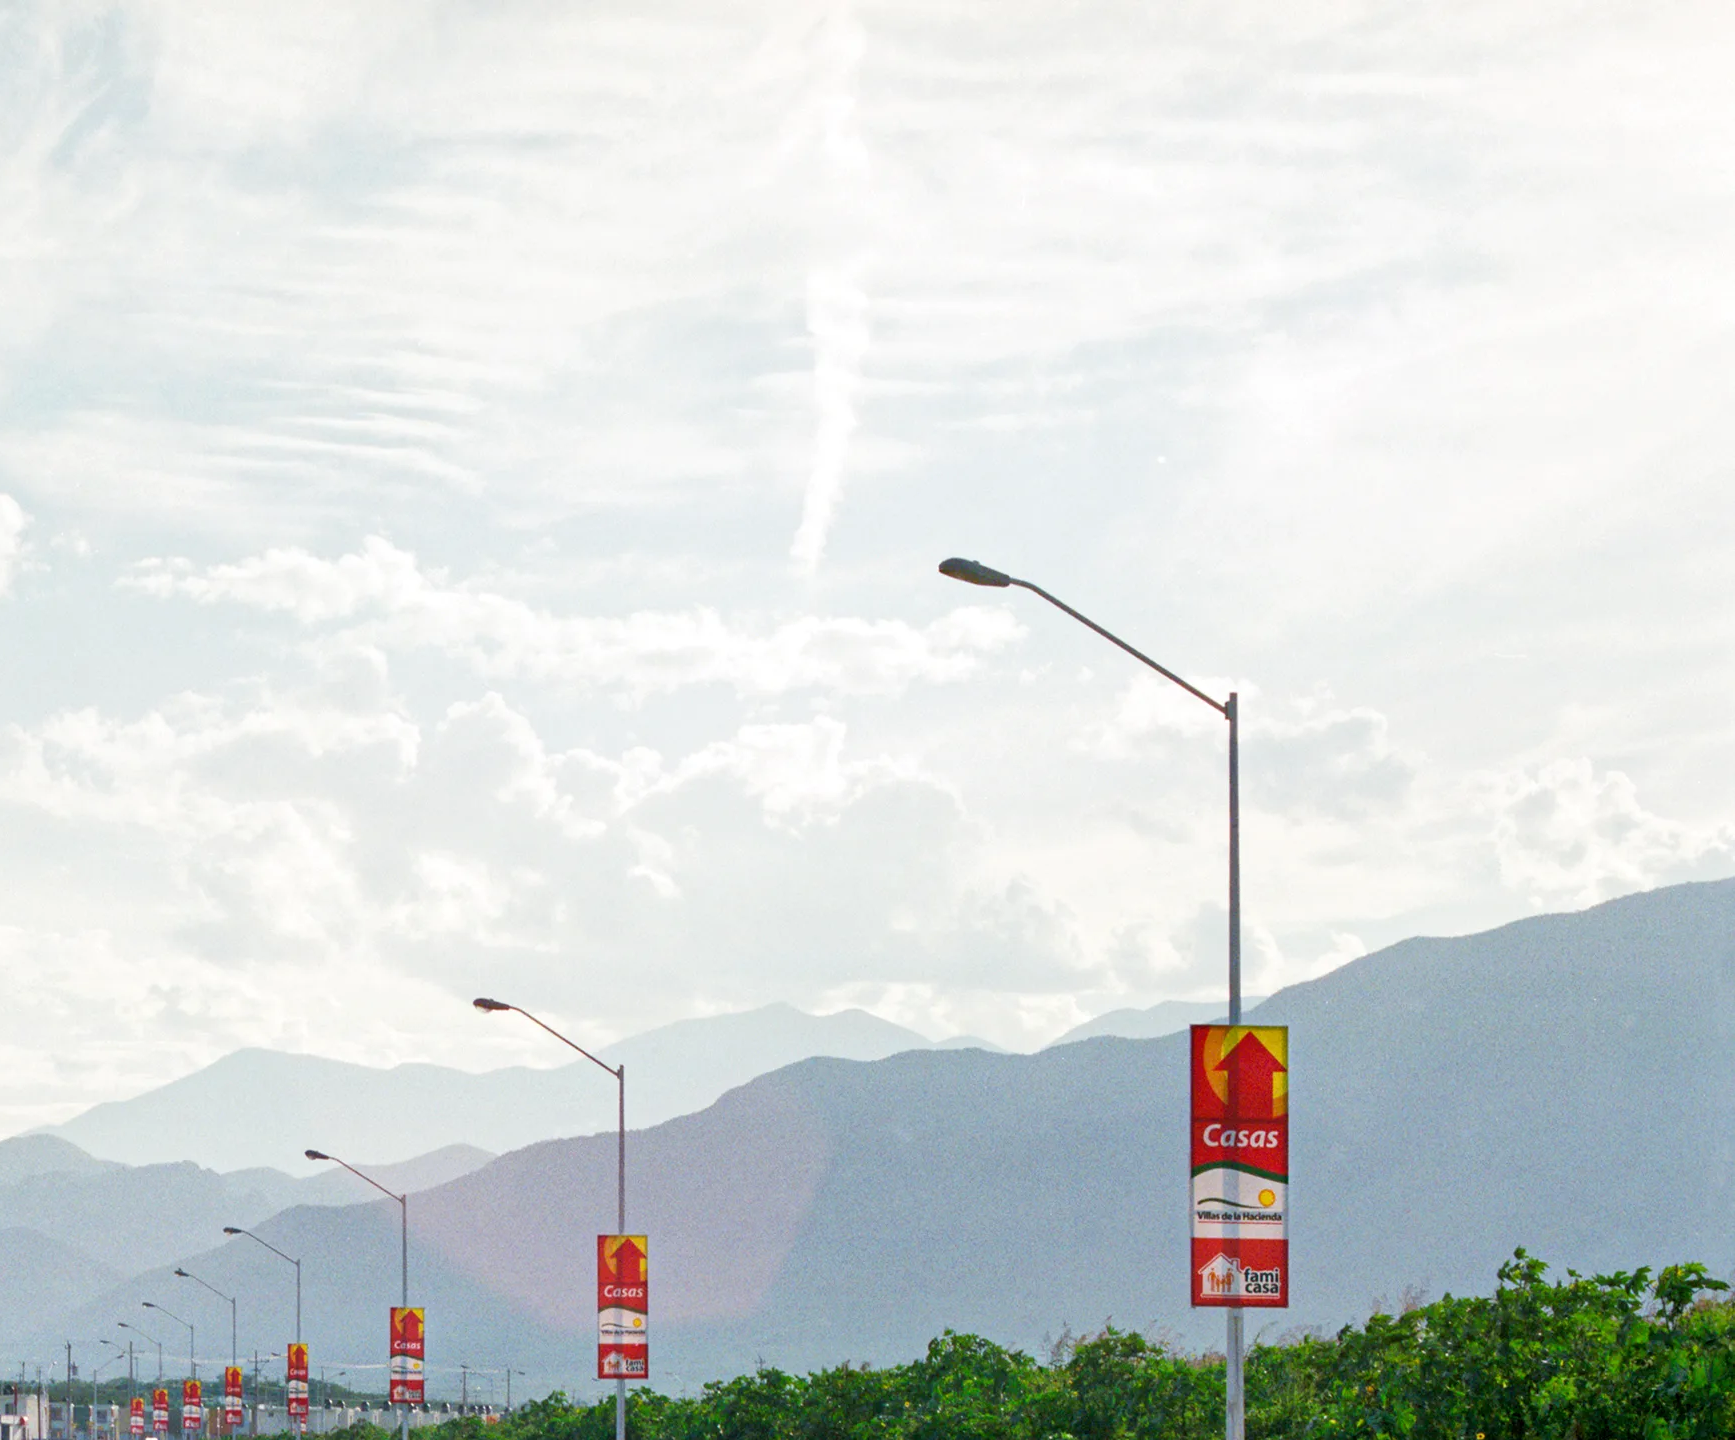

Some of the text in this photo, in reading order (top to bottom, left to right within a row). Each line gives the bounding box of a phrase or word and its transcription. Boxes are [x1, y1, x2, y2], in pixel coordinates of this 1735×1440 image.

[1203, 1123, 1279, 1148] Casas
[1197, 1211, 1282, 1222] Villas de la Hacienda
[1244, 1268, 1279, 1283] fami
[604, 1285, 643, 1298] Casas
[1245, 1282, 1279, 1294] casa
[394, 1340, 421, 1350] Casas
